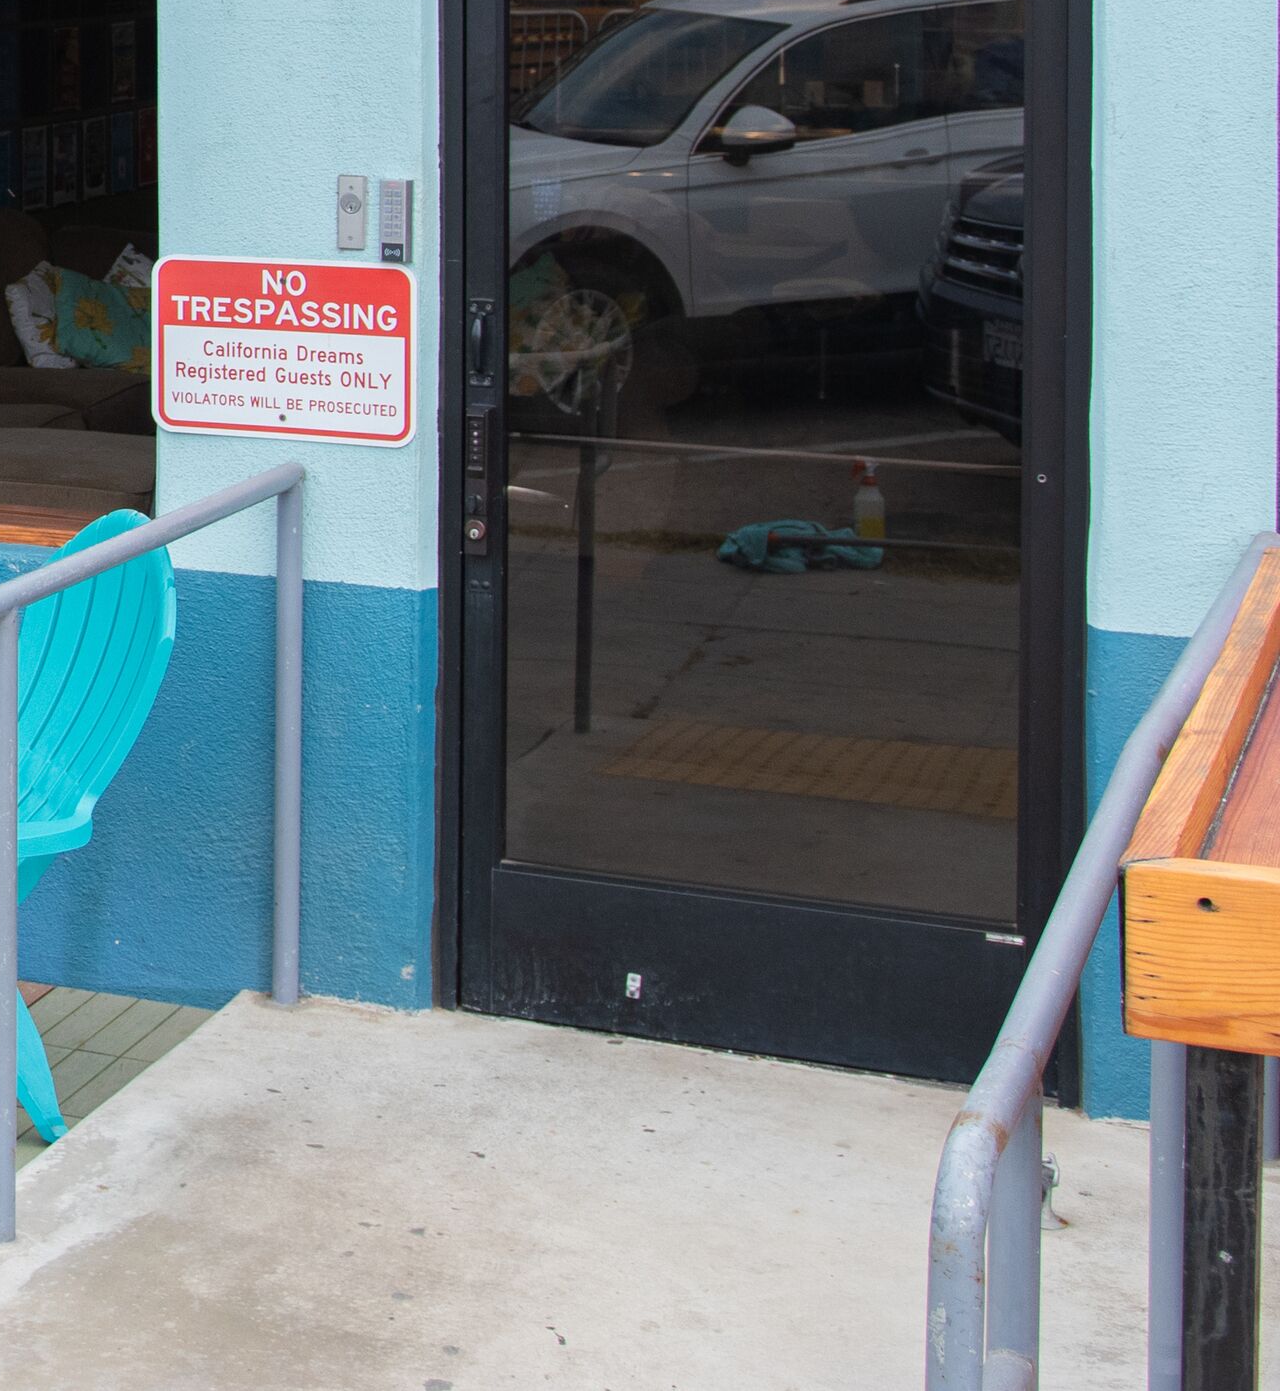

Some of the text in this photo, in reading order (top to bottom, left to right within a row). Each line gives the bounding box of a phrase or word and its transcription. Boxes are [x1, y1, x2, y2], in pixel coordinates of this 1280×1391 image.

[261, 269, 307, 297] NO
[171, 295, 398, 332] TRESPASSING
[203, 340, 364, 365] California Dreams
[175, 362, 392, 390] Registered Guests ONLY
[172, 391, 397, 417] VIOLATORS WILL BE PROSECUTED
